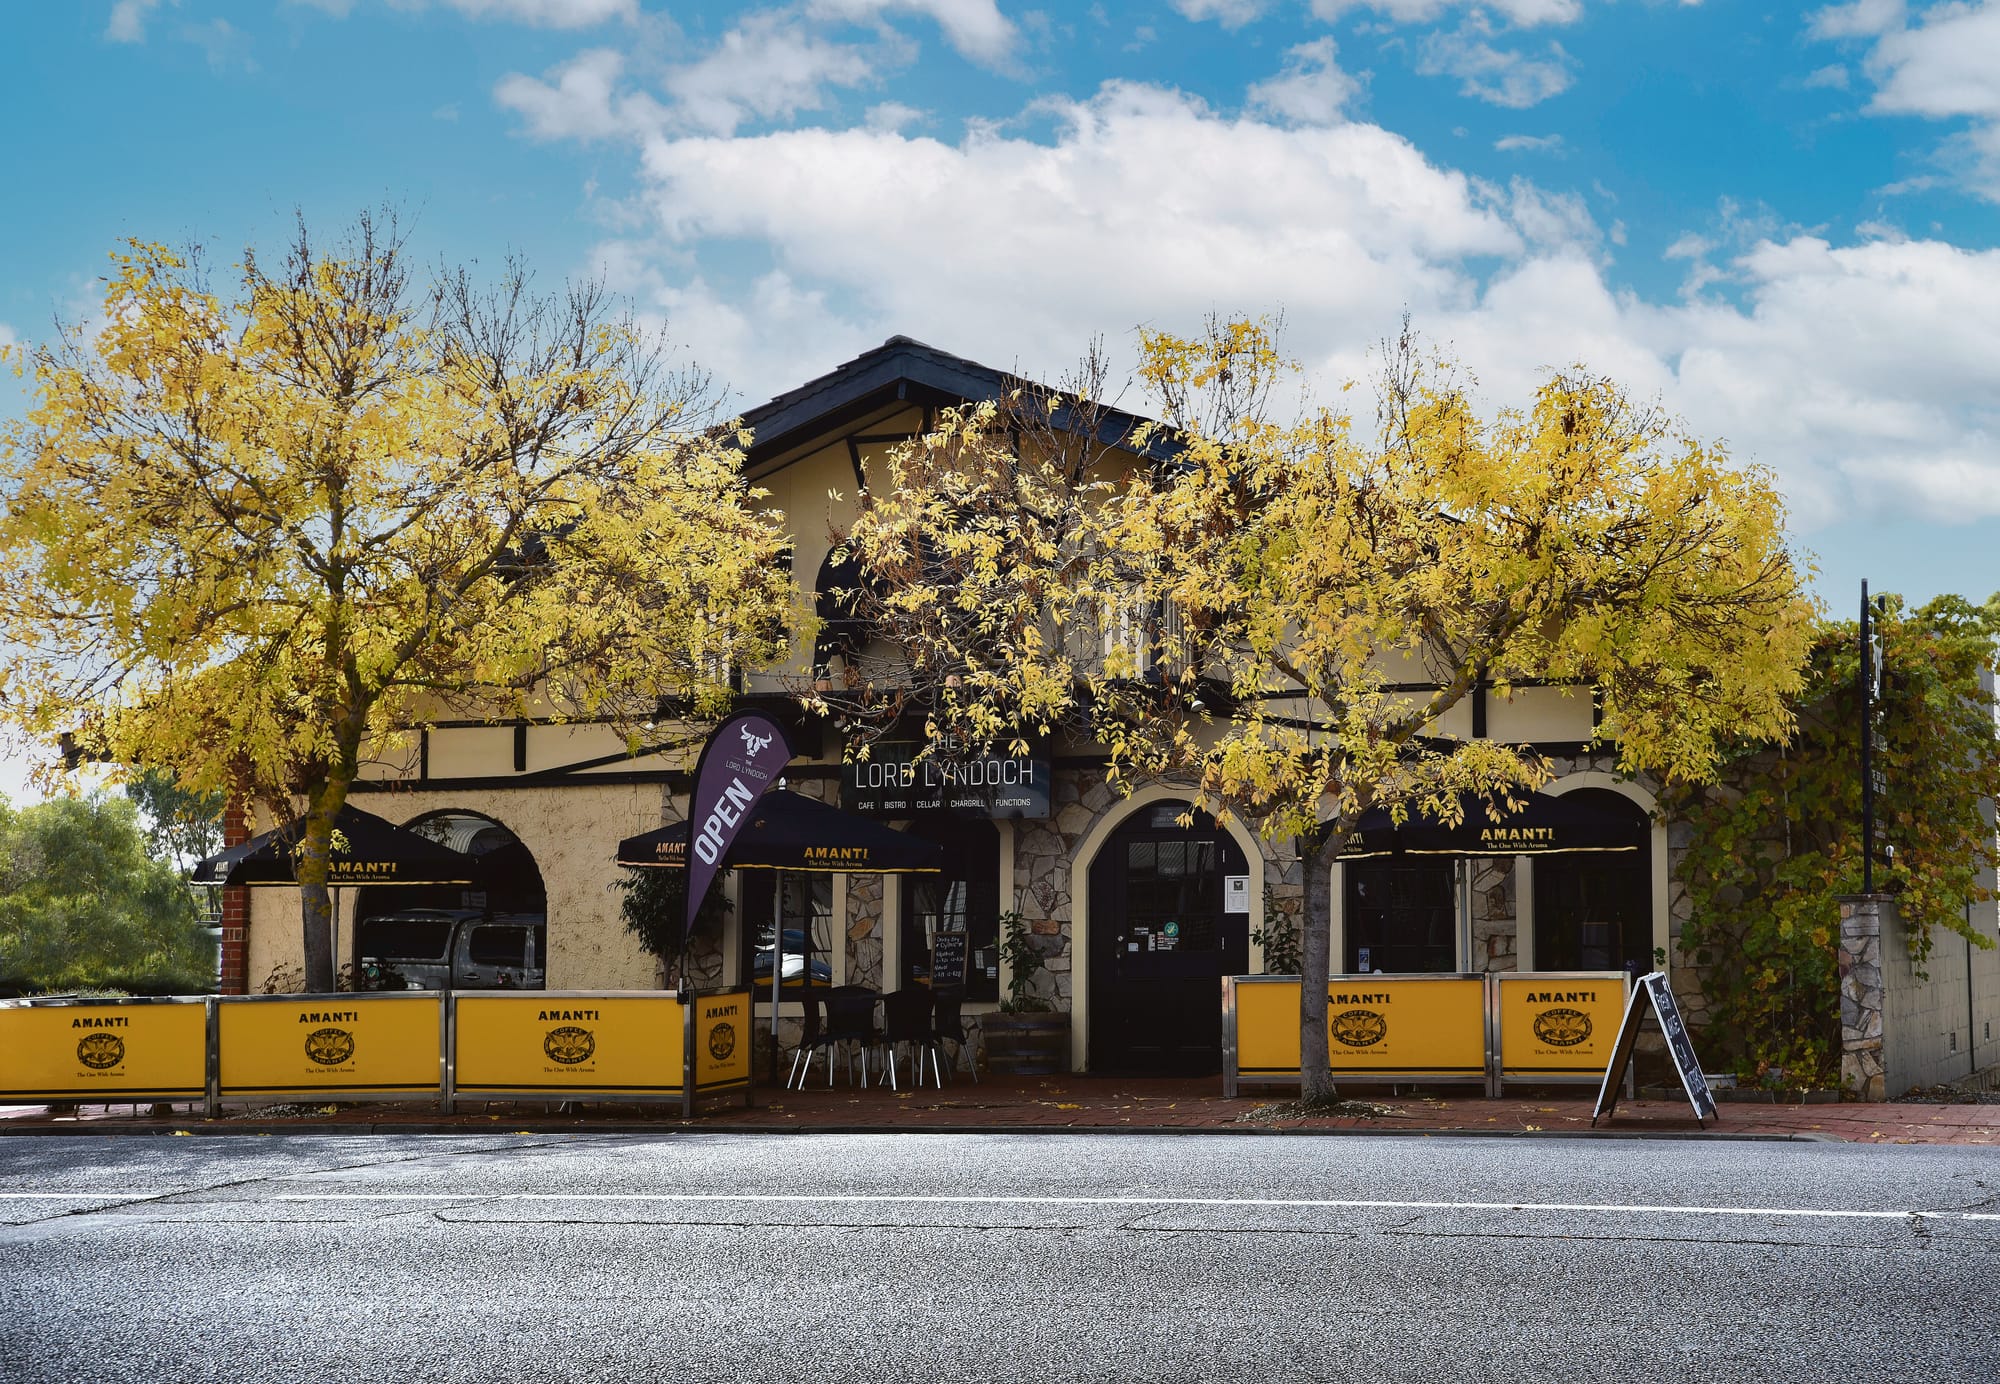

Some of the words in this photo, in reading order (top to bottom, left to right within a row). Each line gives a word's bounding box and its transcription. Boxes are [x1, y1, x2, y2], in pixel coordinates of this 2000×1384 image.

[725, 760, 741, 773] LORD
[741, 766, 768, 780] LYNDOCH
[855, 762, 913, 788] LORD
[925, 760, 1033, 787] LYNDOCH
[858, 801, 875, 810] CAFE
[884, 800, 907, 809] BISTRO
[916, 800, 941, 809] CELLAR
[950, 799, 985, 808] CHARGRILL
[995, 798, 1031, 807] FUNCTIONS
[694, 777, 754, 865] OPEN
[1480, 828, 1553, 841] AMANTI
[656, 842, 686, 853] AMANT
[803, 847, 868, 859] AMANTI
[328, 862, 397, 872] AMANTI
[1328, 994, 1390, 1005] AMANTI
[1526, 992, 1596, 1003] AMANTI
[298, 1011, 358, 1023] AMANTI
[538, 1010, 599, 1021] AMANTI
[705, 1005, 738, 1019] AMANTI
[72, 1017, 129, 1028] AMANTI
